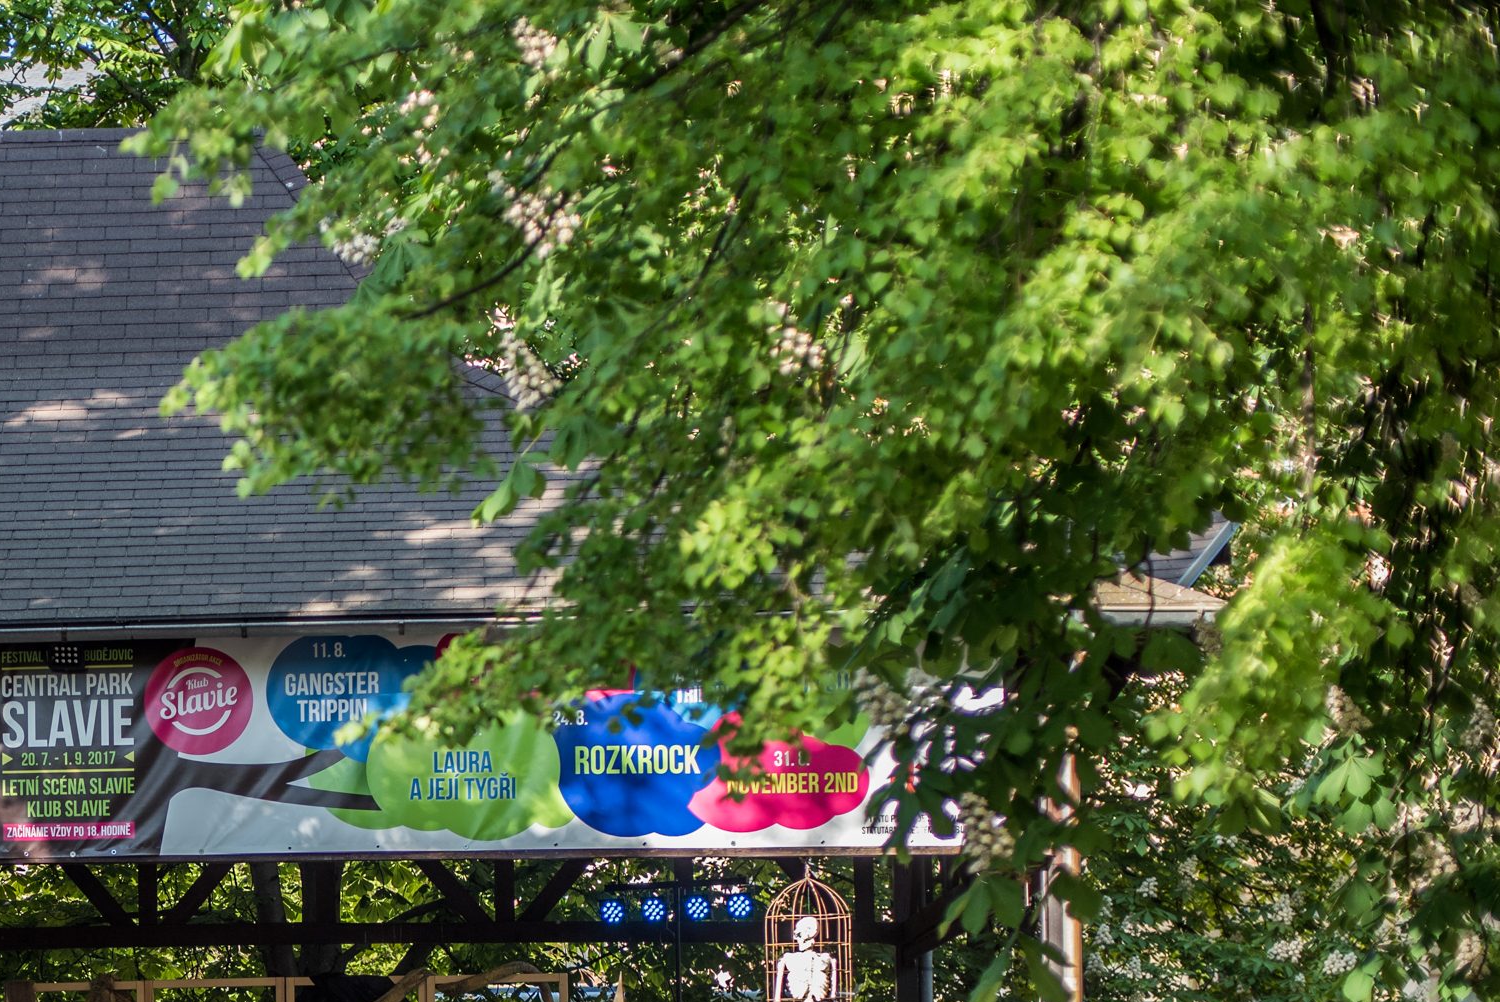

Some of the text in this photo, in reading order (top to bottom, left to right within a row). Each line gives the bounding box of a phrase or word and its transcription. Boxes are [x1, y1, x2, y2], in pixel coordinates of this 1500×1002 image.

[1, 651, 43, 664] FESTIVAL
[84, 647, 134, 661] BUDĚJOVIC
[1, 672, 133, 698] CENTRAL PARK
[186, 677, 209, 690] Klub
[284, 671, 380, 696] GANGSTER
[160, 682, 238, 719] Slavie
[297, 698, 367, 723] TRIPPIN
[2, 699, 134, 749] SLAVIE
[88, 751, 116, 765] 2017
[433, 750, 492, 774] LAURA
[574, 744, 700, 775] ROZKROCK
[2, 775, 135, 796] LETNÍ SCÉNA SLAVIE
[410, 772, 516, 801] A JEJÍ TYGŘI
[824, 772, 859, 793] 2ND
[27, 799, 111, 818] KLUB SLAVIE
[7, 823, 131, 838] ZAČÍNÁME VŽDY PO 18. HODINĚ
